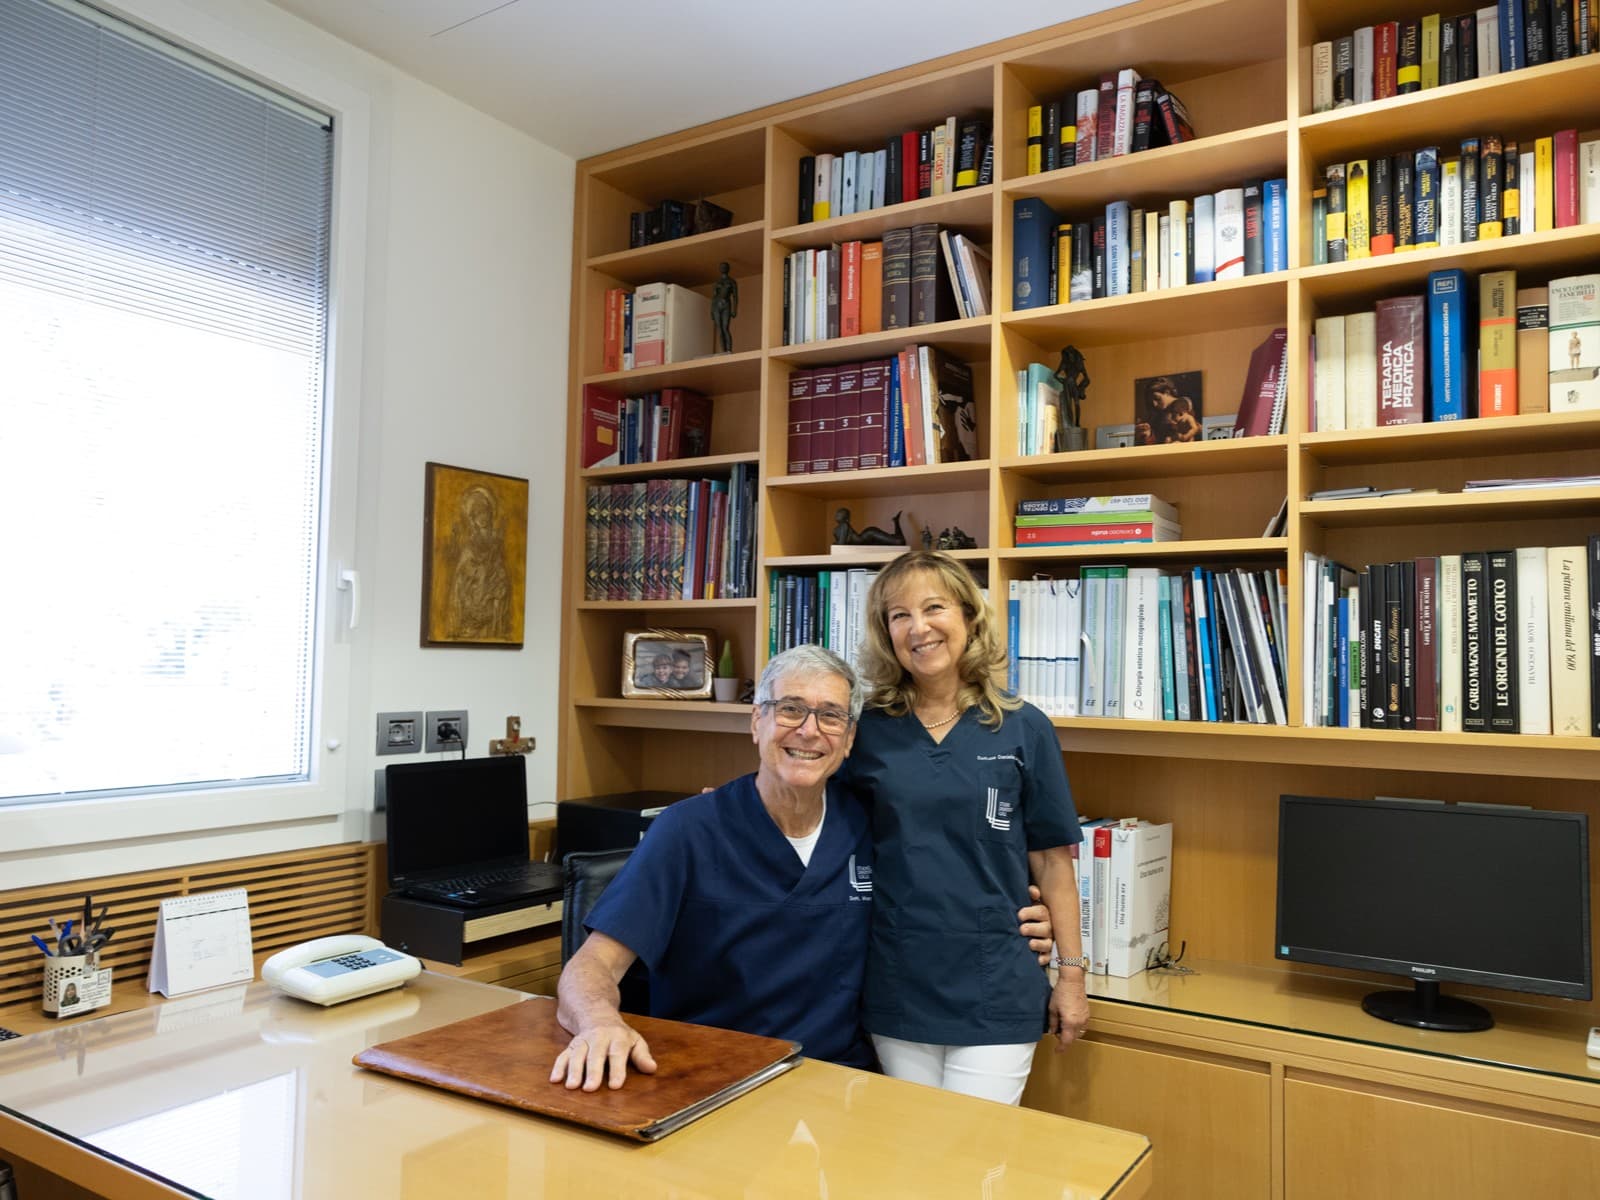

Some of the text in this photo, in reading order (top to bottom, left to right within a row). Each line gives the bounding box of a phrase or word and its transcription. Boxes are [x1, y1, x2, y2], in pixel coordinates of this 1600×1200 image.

[1340, 42, 1349, 71] VITALI
[1407, 26, 1415, 56] VITALI
[1320, 44, 1328, 74] VITALI
[936, 160, 944, 180] CASTA
[1382, 341, 1392, 409] TERAPIA
[1393, 345, 1402, 408] MEDICA
[1404, 341, 1414, 407] PRATICA
[866, 416, 872, 424] 4
[1467, 579, 1478, 632] MAOMETTO
[1494, 579, 1506, 622] GOTICO
[1561, 560, 1576, 670] La pittura emiliana del '600
[1136, 604, 1144, 646] mucogengivale
[1495, 624, 1507, 645] DEL
[1468, 642, 1478, 677] MAGNO
[1496, 647, 1508, 691] ORIGINI
[1528, 647, 1536, 685] FRANCESCO
[1469, 679, 1479, 710] CARLO
[1497, 693, 1508, 706] LE
[1081, 876, 1090, 897] DIGITALE
[1082, 899, 1090, 929] RIVOLUZIONE
[1411, 966, 1436, 974] PHILIPS
